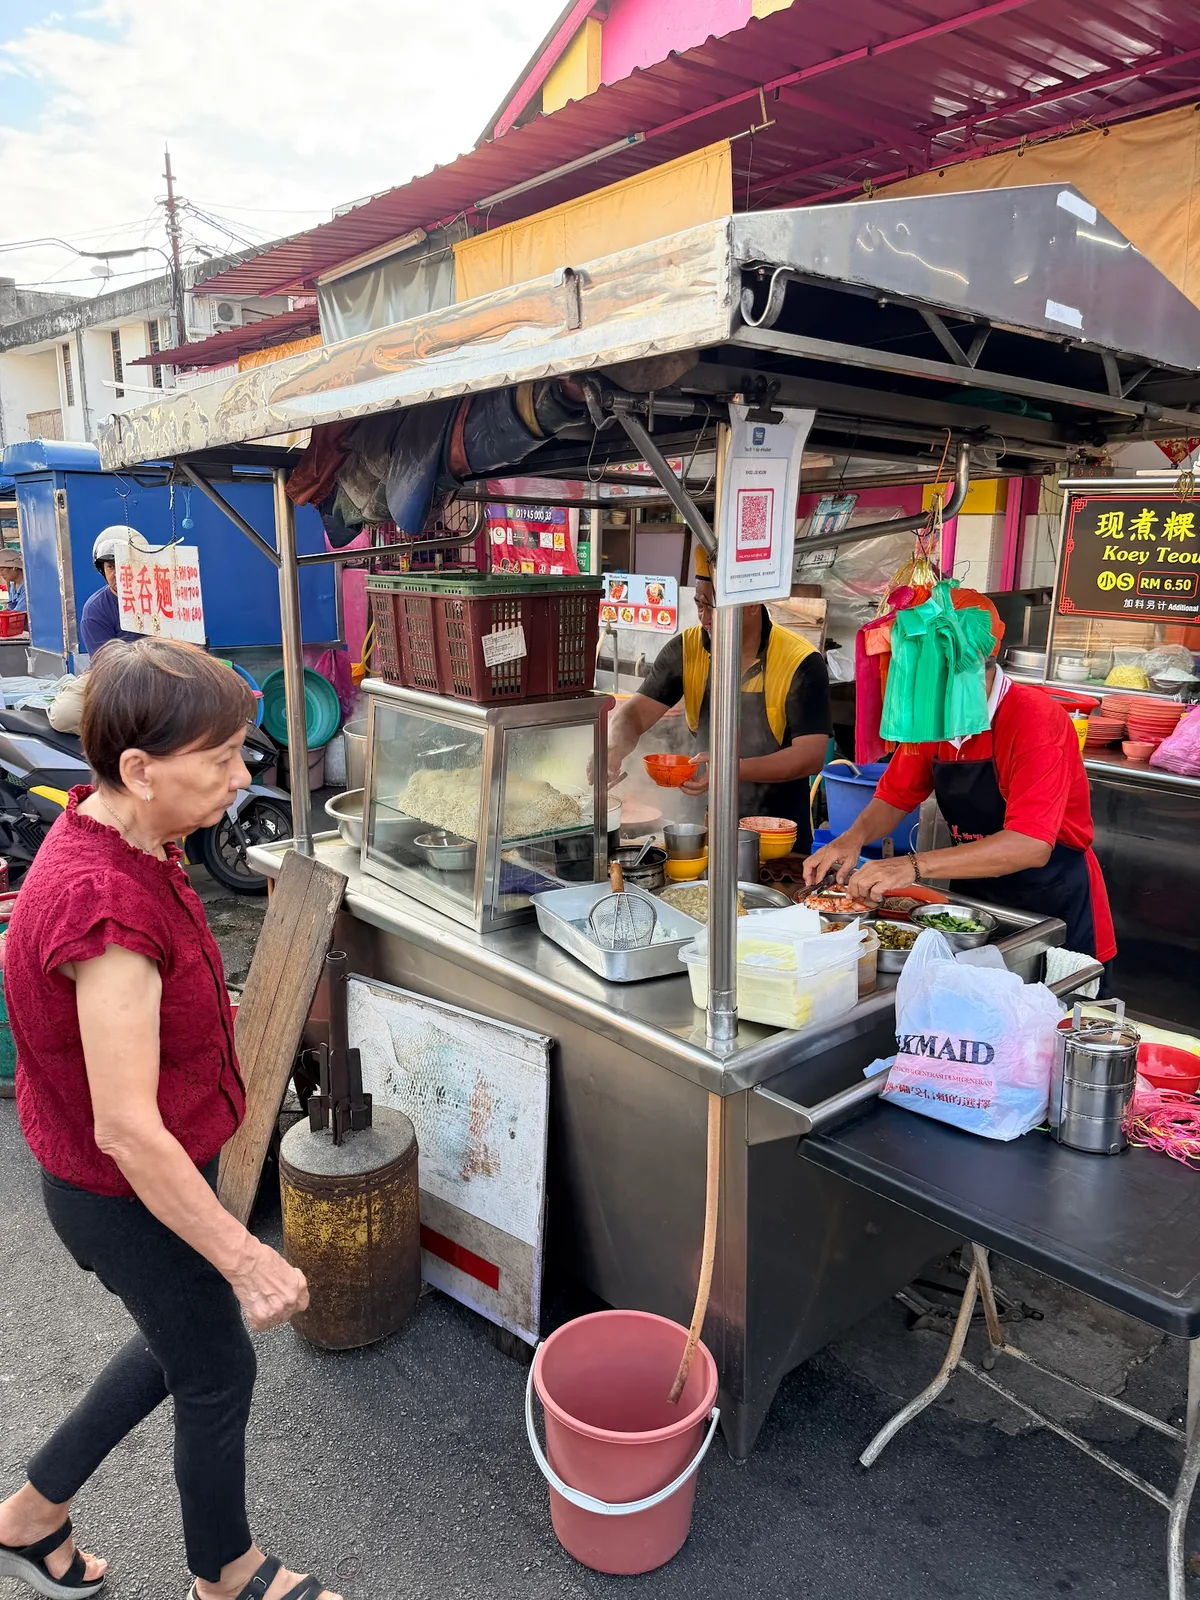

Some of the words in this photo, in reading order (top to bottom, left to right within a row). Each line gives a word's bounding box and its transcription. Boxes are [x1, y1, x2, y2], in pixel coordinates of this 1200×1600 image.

[1095, 508, 1196, 542] 现煮粿
[1102, 545, 1150, 565] Koey
[120, 565, 173, 618] 雲吞麵
[1100, 574, 1114, 588] 小
[1119, 574, 1131, 589] S
[1140, 577, 1160, 590] RM
[1164, 579, 1192, 591] 6.50
[1123, 598, 1167, 610] 加料另计
[1168, 603, 1199, 612] Additional
[896, 1034, 995, 1065] KMAID
[961, 1077, 993, 1087] GENERASI
